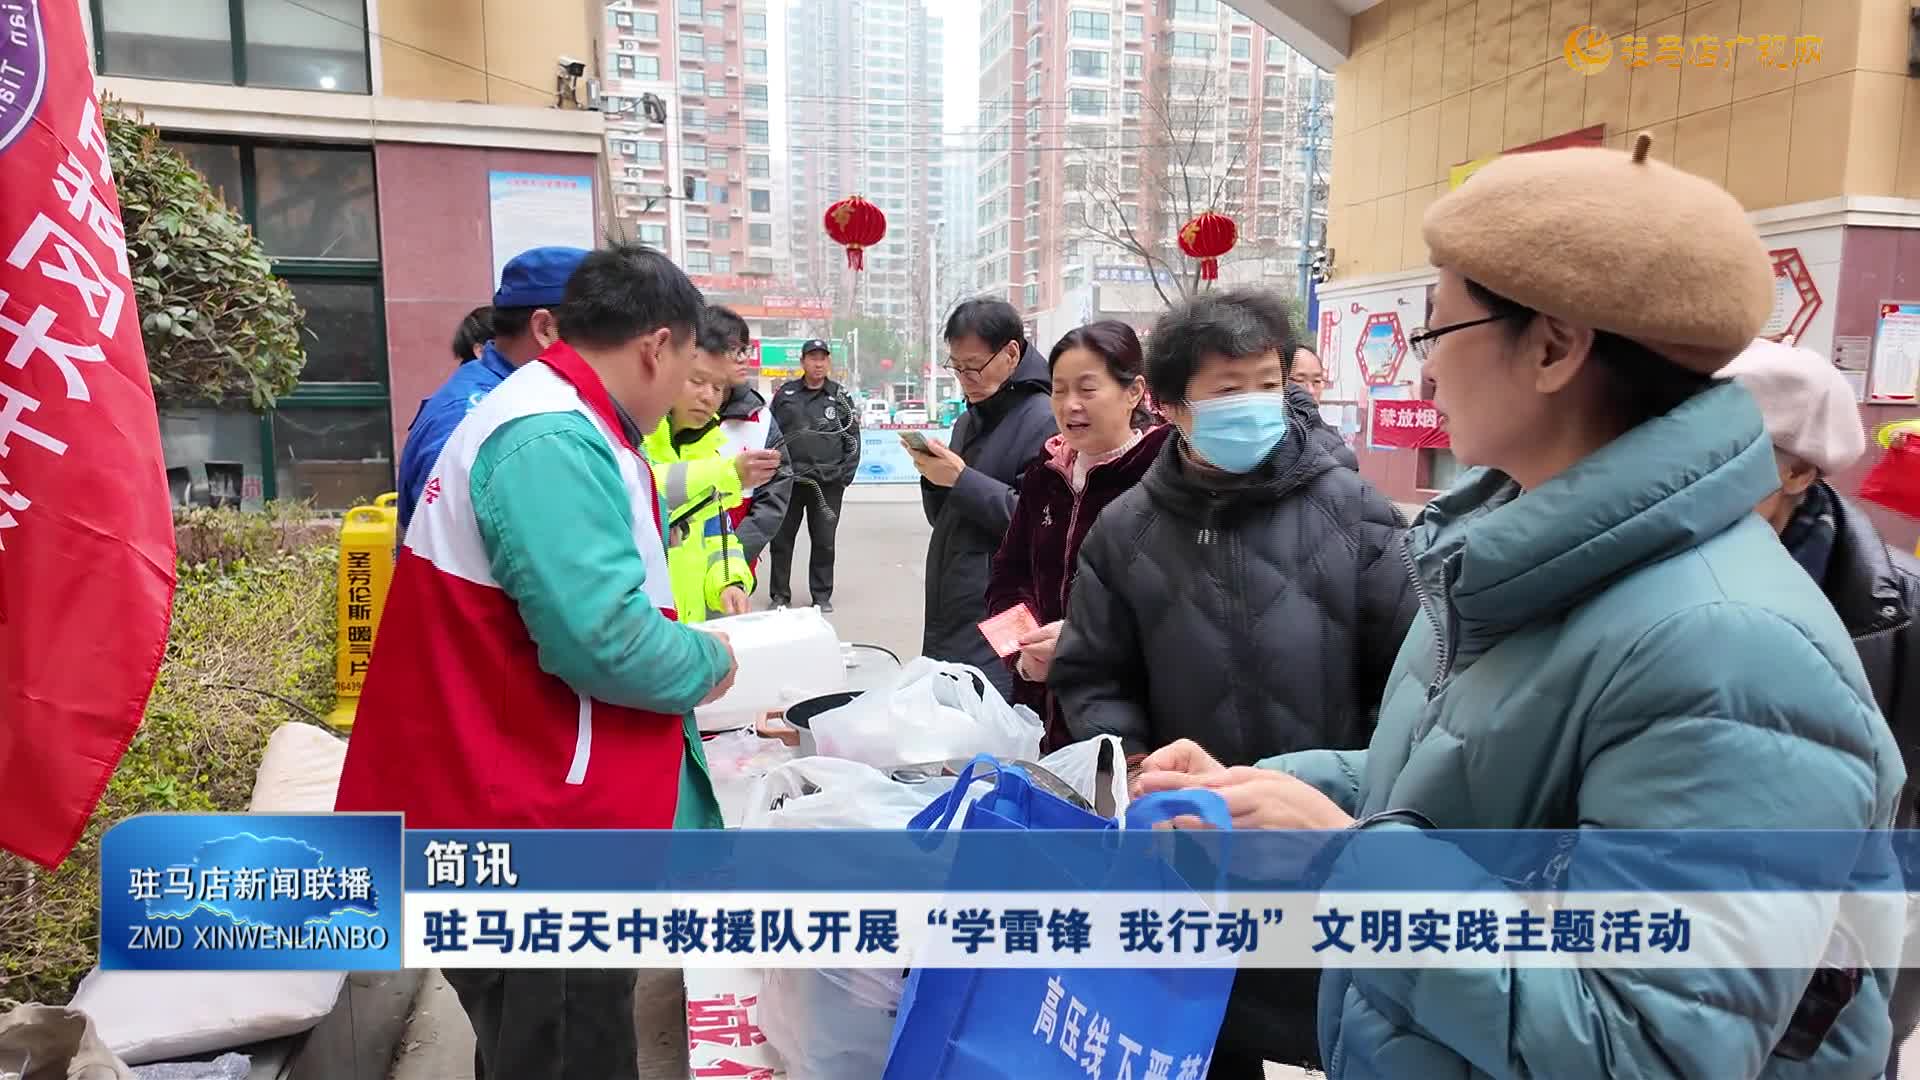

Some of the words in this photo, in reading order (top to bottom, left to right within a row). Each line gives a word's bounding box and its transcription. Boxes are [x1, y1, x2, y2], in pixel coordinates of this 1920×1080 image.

[1380, 407, 1446, 428] 禁放烟
[348, 552, 371, 620] 圣劳伦斯
[348, 627, 371, 676] 暖气片
